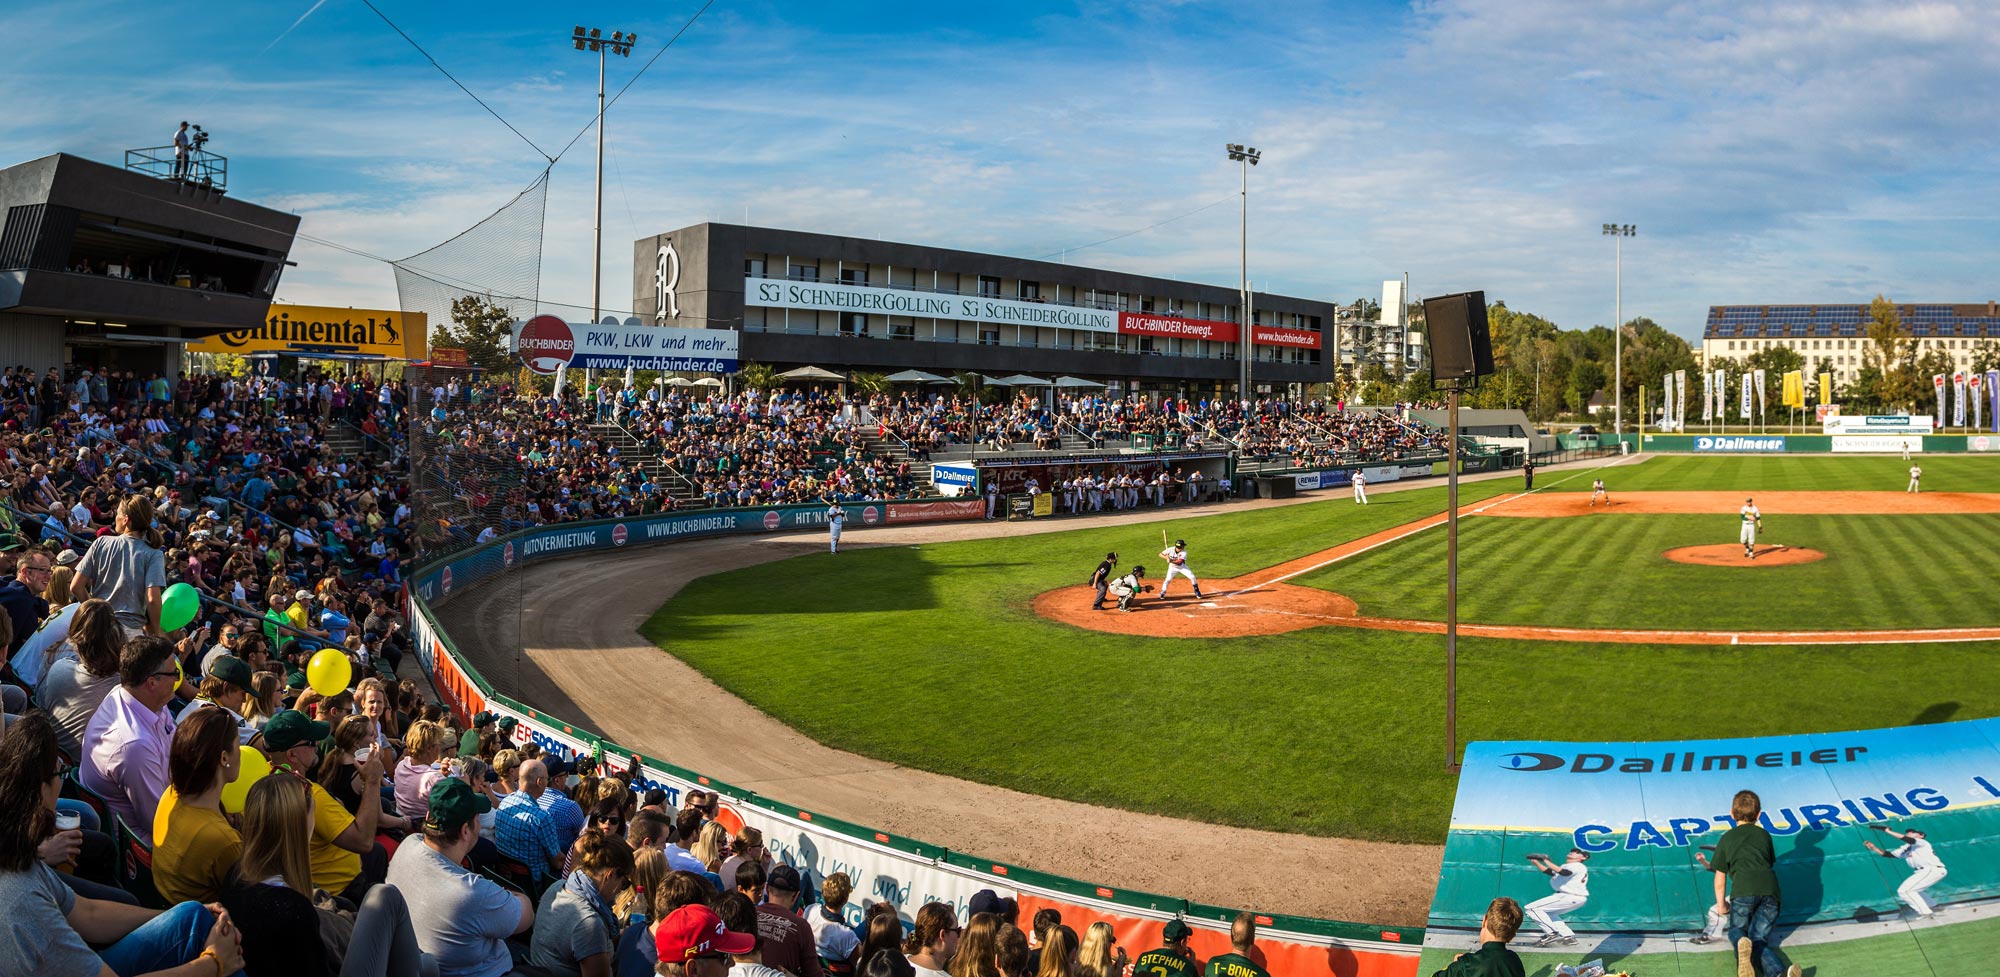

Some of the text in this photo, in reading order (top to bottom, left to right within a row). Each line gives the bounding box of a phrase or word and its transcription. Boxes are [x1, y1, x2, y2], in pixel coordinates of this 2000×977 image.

[656, 243, 680, 320] R
[759, 283, 780, 302] SG
[962, 300, 979, 317] SG
[1125, 317, 1213, 338] BUCHBINDER bewegt.
[518, 338, 574, 350] BUCHBINDER
[586, 331, 739, 352] PKW, LKW und mehr...
[1257, 331, 1315, 345] www.buchbinder.de
[586, 355, 724, 372] www.buchbinder.de
[1714, 437, 1783, 449] Dallmeier
[943, 471, 975, 483] Dallmeier
[1003, 469, 1028, 481] KFC
[647, 516, 736, 538] WWW.BUCHBINDER.DE
[795, 512, 811, 524] HIT
[524, 531, 596, 557] AUTOVERMIETUNG
[1570, 746, 1868, 774] Dallmeier
[872, 875, 912, 906] und
[1140, 954, 1186, 972] STEPHAN
